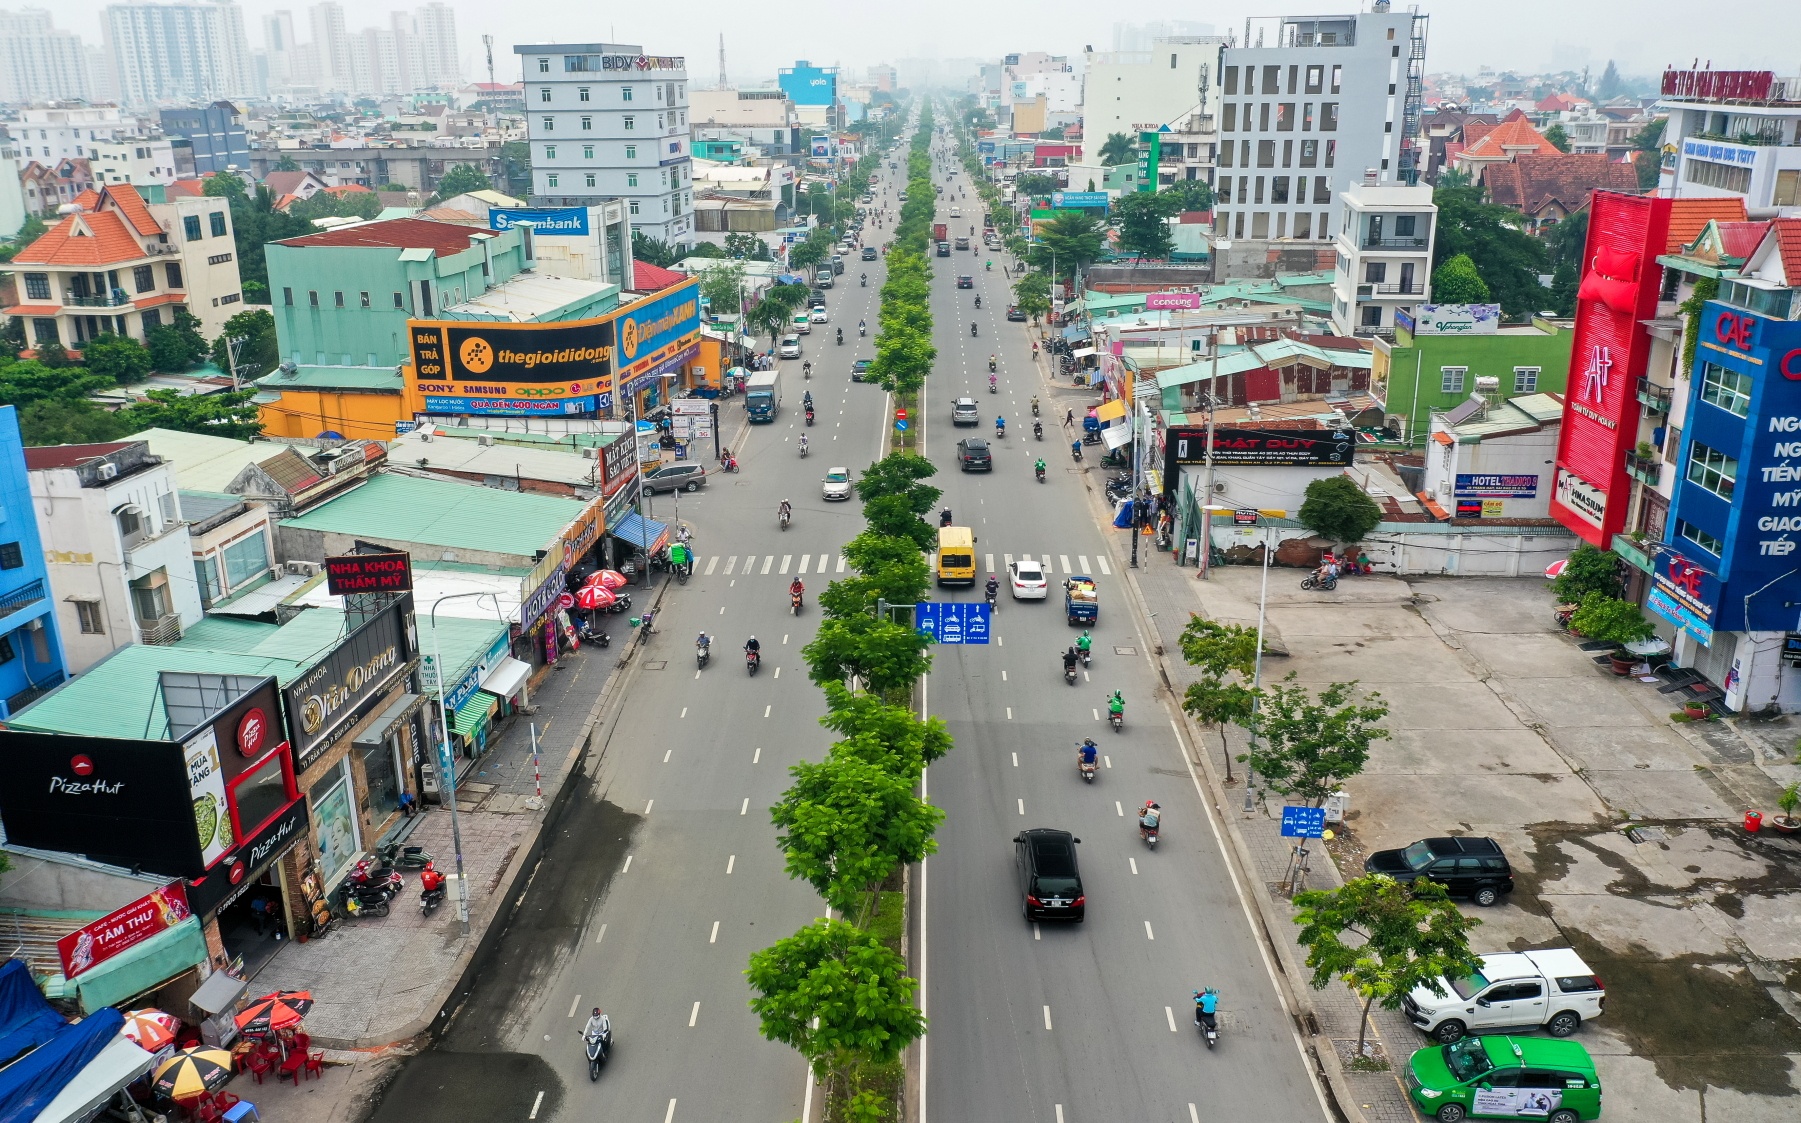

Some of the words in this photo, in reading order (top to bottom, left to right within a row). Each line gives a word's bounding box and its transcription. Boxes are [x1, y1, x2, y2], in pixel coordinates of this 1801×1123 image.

[602, 56, 634, 69] BIDV
[1061, 63, 1073, 73] ila
[809, 77, 827, 87] yola
[496, 214, 581, 230] Sambank
[1715, 311, 1755, 351] CAE
[417, 335, 437, 345] BÁN
[420, 349, 439, 360] TRẢ
[498, 345, 610, 369] thegioididong
[420, 364, 441, 375] GÓP
[417, 384, 455, 393] SONY
[463, 385, 507, 395] SAMSUNG
[470, 398, 491, 410] QUÀ
[492, 398, 511, 410] ĐẾN
[512, 401, 531, 410] 400
[533, 400, 560, 410] NGÀN
[1266, 439, 1316, 449] DUY
[1472, 476, 1501, 486] HOTEL
[1759, 534, 1796, 556] TIẾP
[330, 562, 361, 574] NHA
[365, 560, 406, 573] KHOA
[381, 572, 402, 587] MỸ
[1669, 554, 1705, 599] CAE
[293, 683, 310, 699] NHA
[309, 667, 328, 686] KHOA
[410, 723, 420, 764] CLINIC
[190, 755, 208, 773] MUA
[95, 924, 125, 945] TÂM
[125, 908, 154, 929] THƯ
